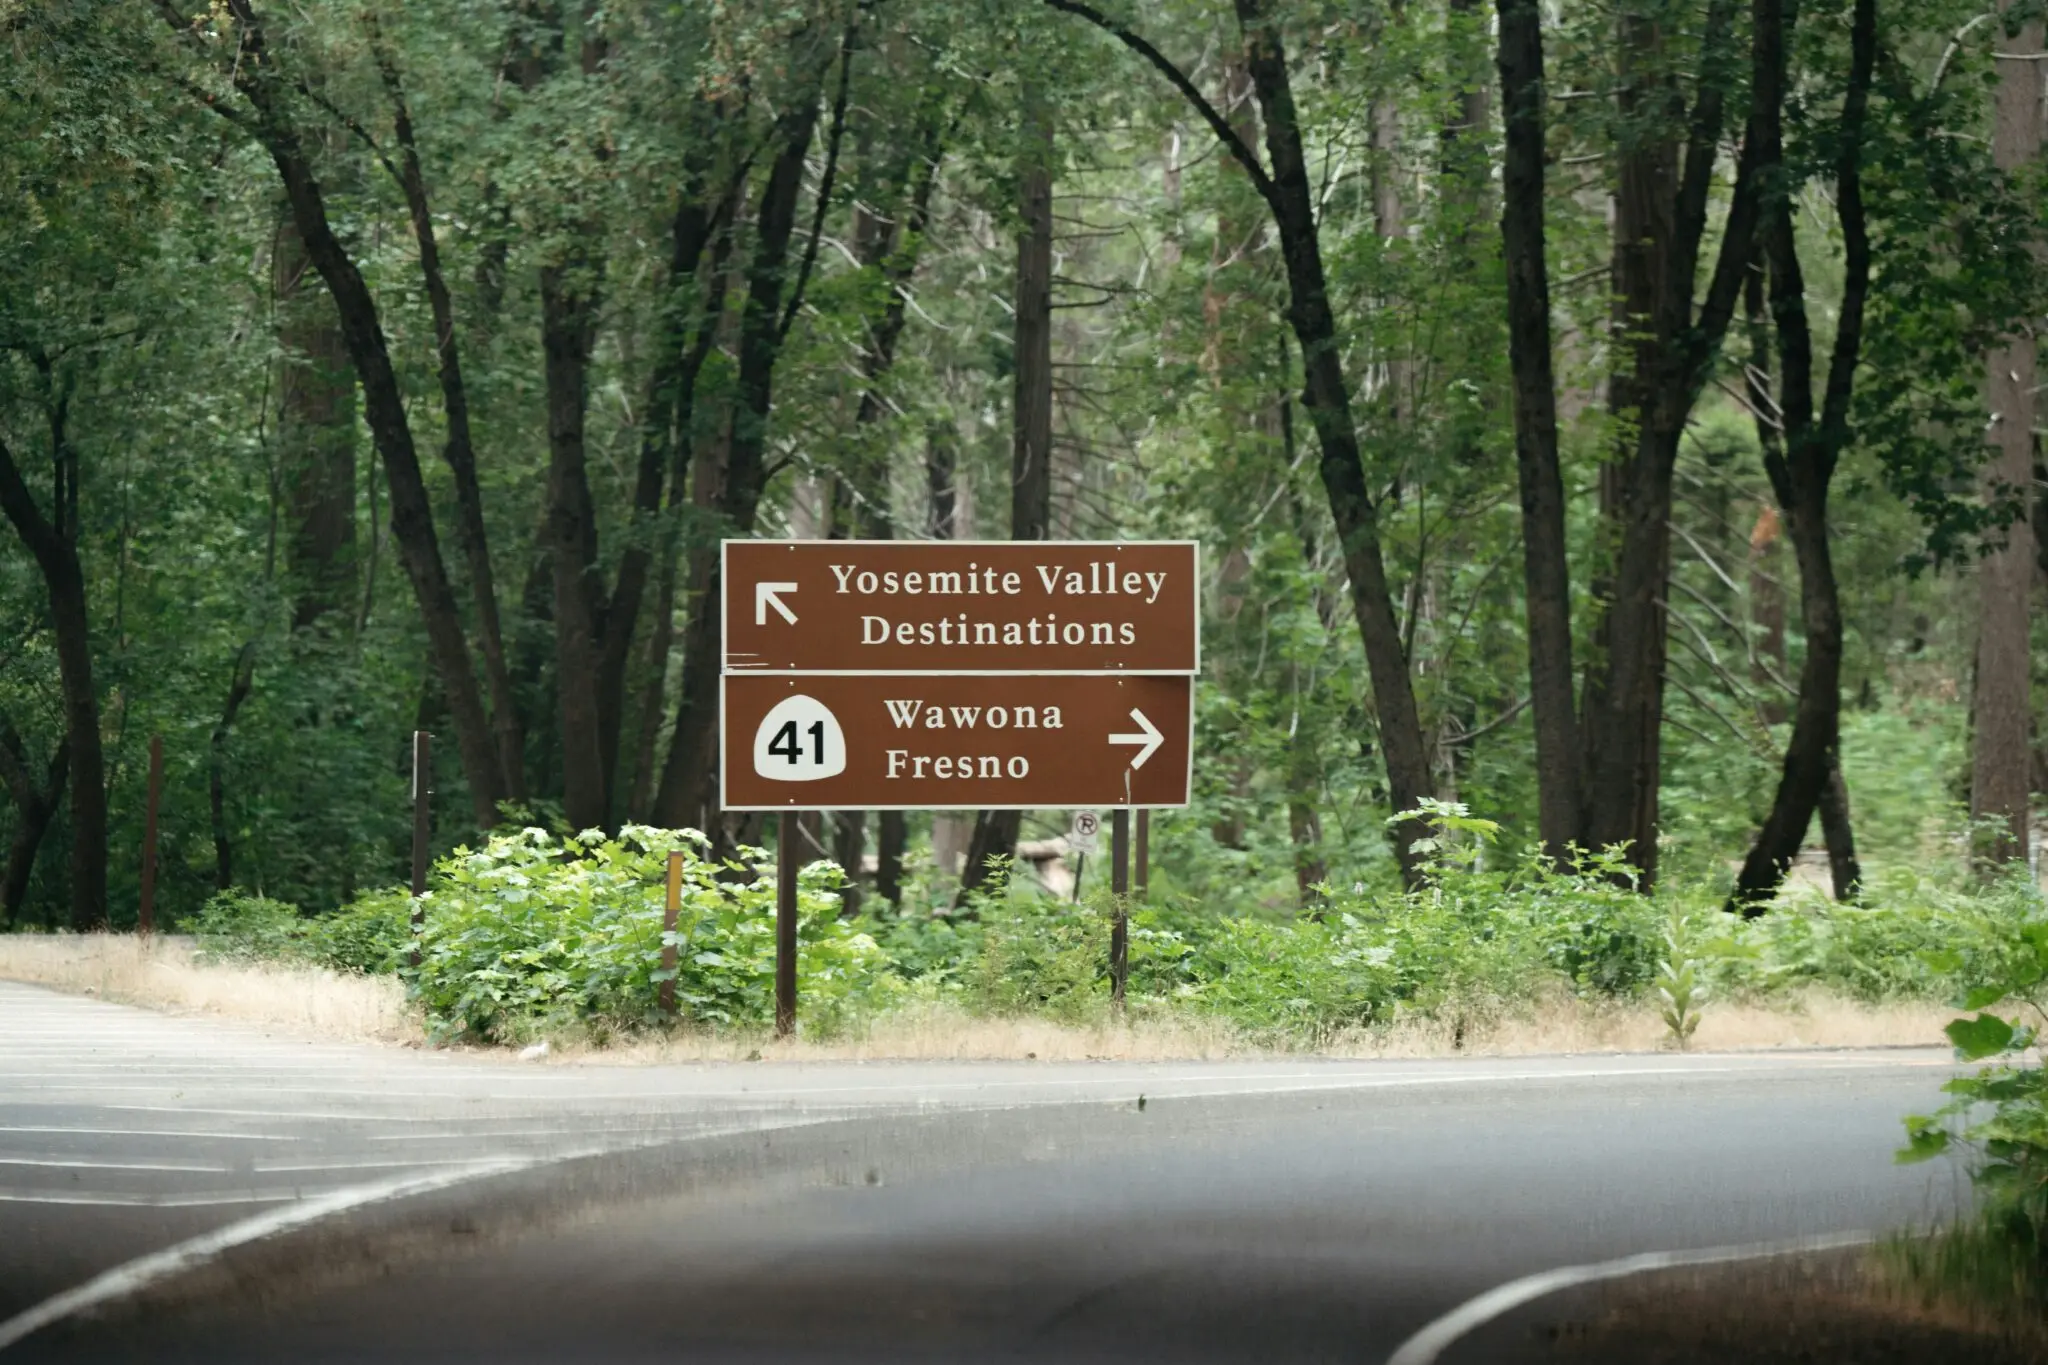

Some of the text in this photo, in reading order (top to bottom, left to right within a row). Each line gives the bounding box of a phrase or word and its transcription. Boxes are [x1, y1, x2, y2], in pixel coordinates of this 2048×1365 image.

[829, 562, 1167, 604] Yosemite Valley
[861, 614, 1136, 645] Destinations
[884, 700, 1064, 728] Wawona
[768, 721, 824, 764] 41
[886, 750, 1030, 778] Fresno
